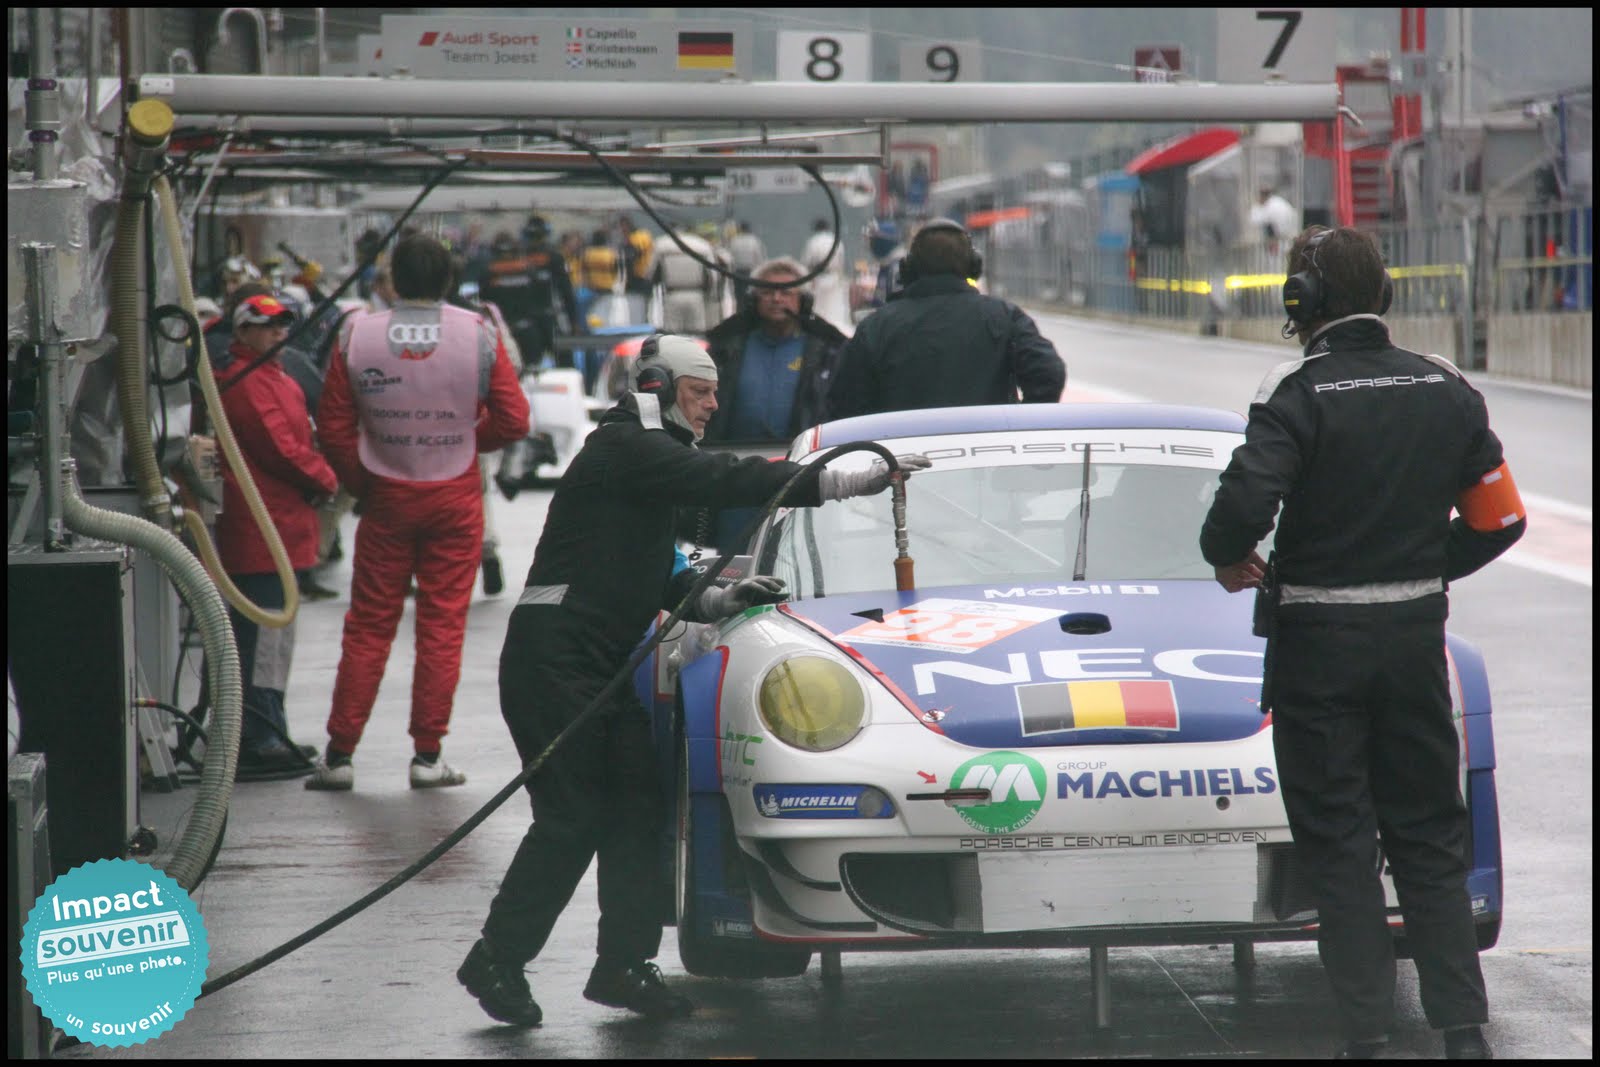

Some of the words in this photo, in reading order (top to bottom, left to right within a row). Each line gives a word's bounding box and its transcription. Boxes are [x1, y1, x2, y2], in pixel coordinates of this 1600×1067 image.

[442, 31, 483, 45] Audi
[488, 31, 540, 47] Sport
[585, 28, 637, 40] Capello
[1256, 11, 1303, 69] 7
[441, 48, 489, 63] Team
[493, 50, 538, 64] Joest
[805, 37, 842, 81] 8
[925, 45, 959, 82] 9
[1314, 373, 1446, 393] PORSCHE
[860, 611, 1020, 643] 98
[911, 647, 1264, 696] NEC
[1056, 761, 1107, 771] GROUP
[1056, 767, 1277, 800] MACHIELS
[780, 796, 857, 808] MICHELIN
[958, 810, 990, 834] CLOSING
[993, 825, 1009, 834] THE
[1012, 808, 1036, 830] CIRCLE
[960, 836, 1054, 849] PORSCHE
[1063, 834, 1158, 847] CENTRUM
[1164, 831, 1267, 846] EINDHOVEN
